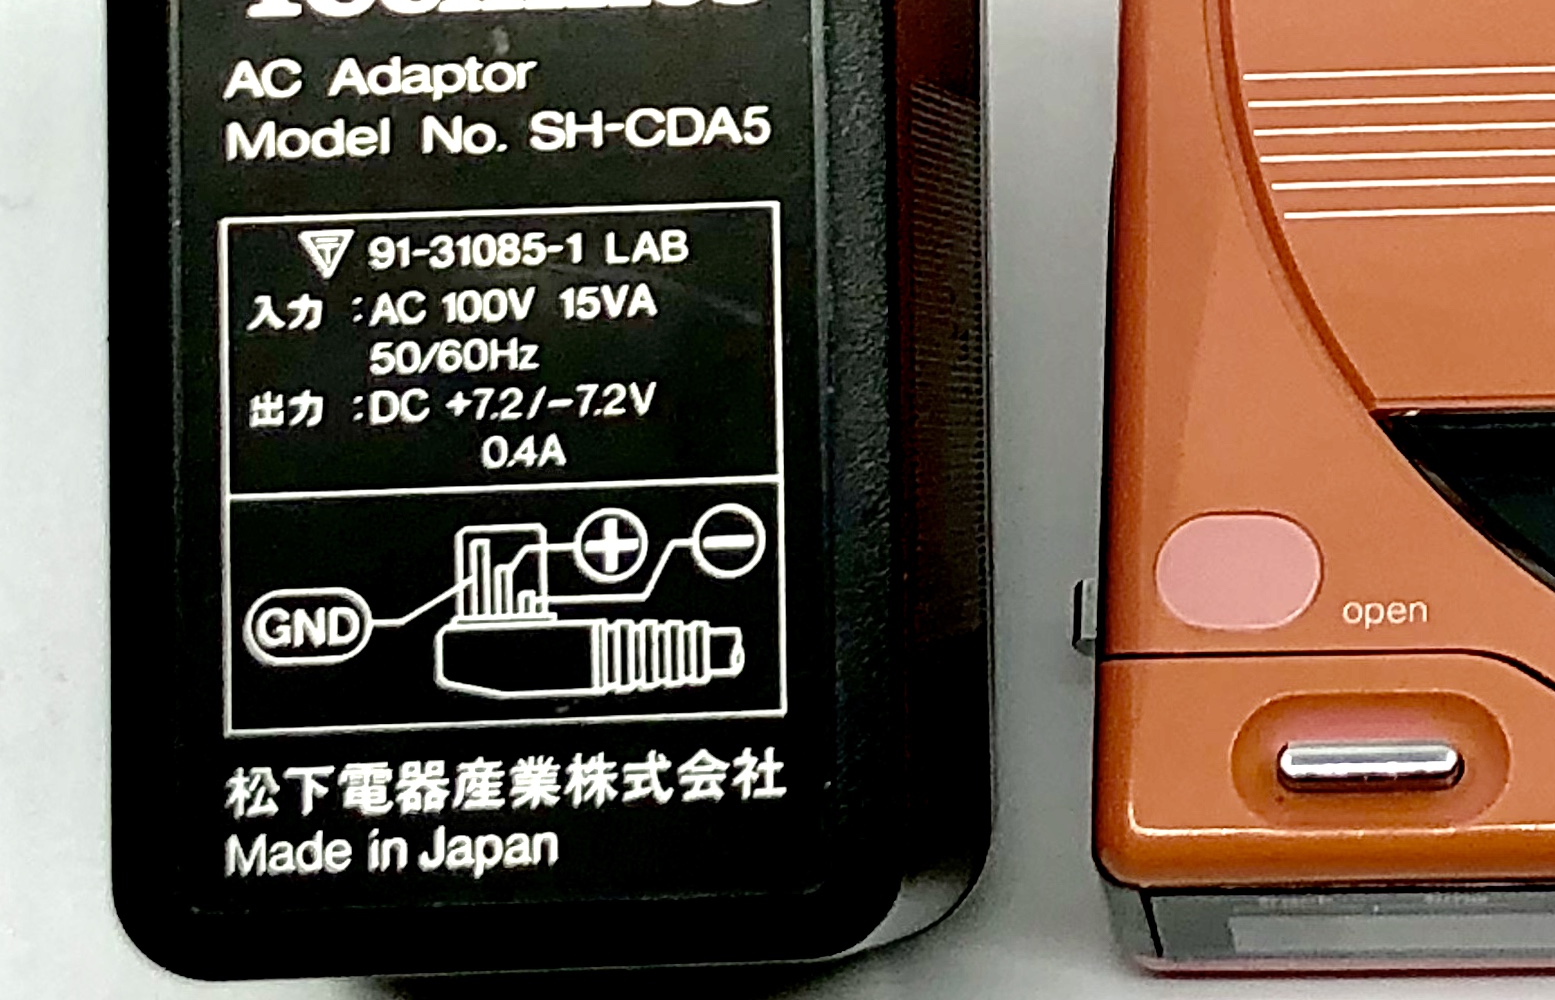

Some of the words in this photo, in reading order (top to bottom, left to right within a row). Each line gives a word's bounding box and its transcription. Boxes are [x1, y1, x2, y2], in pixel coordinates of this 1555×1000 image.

[222, 58, 303, 101] AC
[327, 55, 537, 101] Adaptor
[225, 117, 391, 162] Model
[421, 115, 508, 155] No.
[528, 105, 772, 152] SH-CDA5
[367, 232, 583, 271] 91-31085-1
[605, 229, 689, 265] LAB
[246, 293, 323, 331] 入力
[441, 286, 536, 324] 100V
[558, 282, 658, 320] 15VA
[369, 337, 540, 376] 50/60Hz
[249, 389, 324, 428] 出力
[481, 432, 567, 469] 0.4A
[256, 606, 360, 648] GND
[1342, 601, 1428, 630] open
[224, 746, 788, 820] 松下電器産業株式会社
[225, 829, 353, 877] Made
[367, 827, 408, 872] in
[418, 824, 559, 880] Japan
